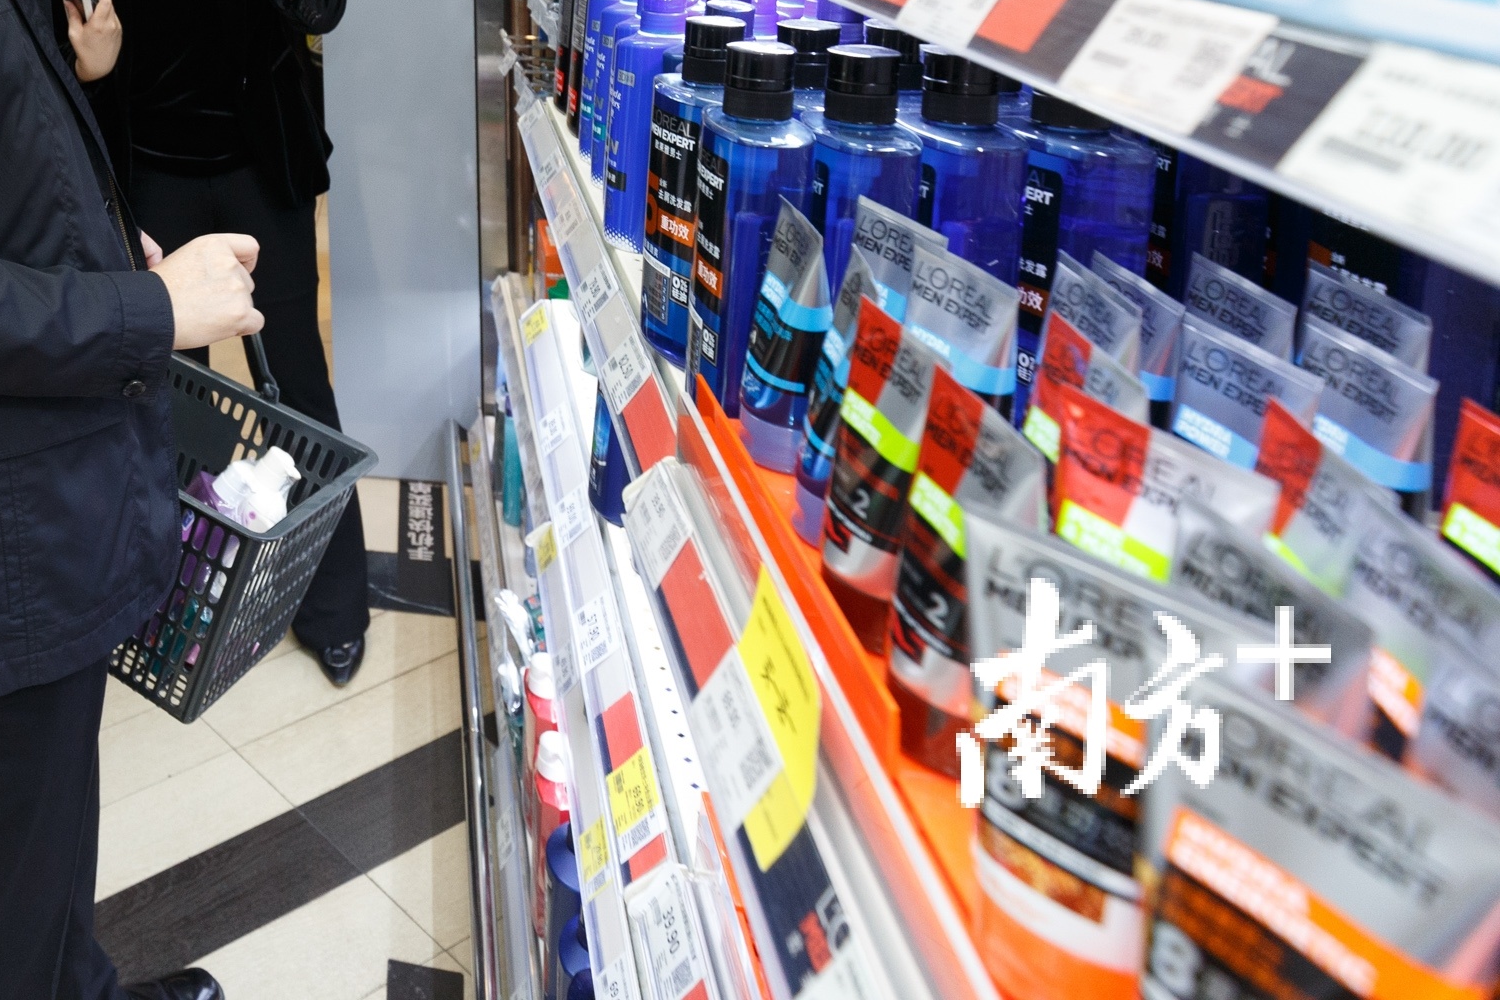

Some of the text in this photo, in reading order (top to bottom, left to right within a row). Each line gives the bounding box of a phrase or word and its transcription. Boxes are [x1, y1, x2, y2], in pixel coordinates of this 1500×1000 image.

[662, 127, 696, 151] EXPERT
[657, 188, 692, 213] 去屑洗发露
[660, 214, 690, 242] 重功效
[856, 233, 912, 272] MEN EXPE
[912, 281, 991, 334] MEN EXPERT
[1188, 292, 1217, 318] MEN
[1217, 307, 1264, 342] EXPERT
[1309, 301, 1344, 328] MEN
[619, 354, 633, 380] 82.50
[1181, 363, 1220, 391] MEN
[851, 489, 870, 518] 2
[587, 612, 600, 642] 57.90
[927, 596, 949, 629] 2
[632, 785, 645, 814] 69.90
[663, 906, 681, 955] 39.90
